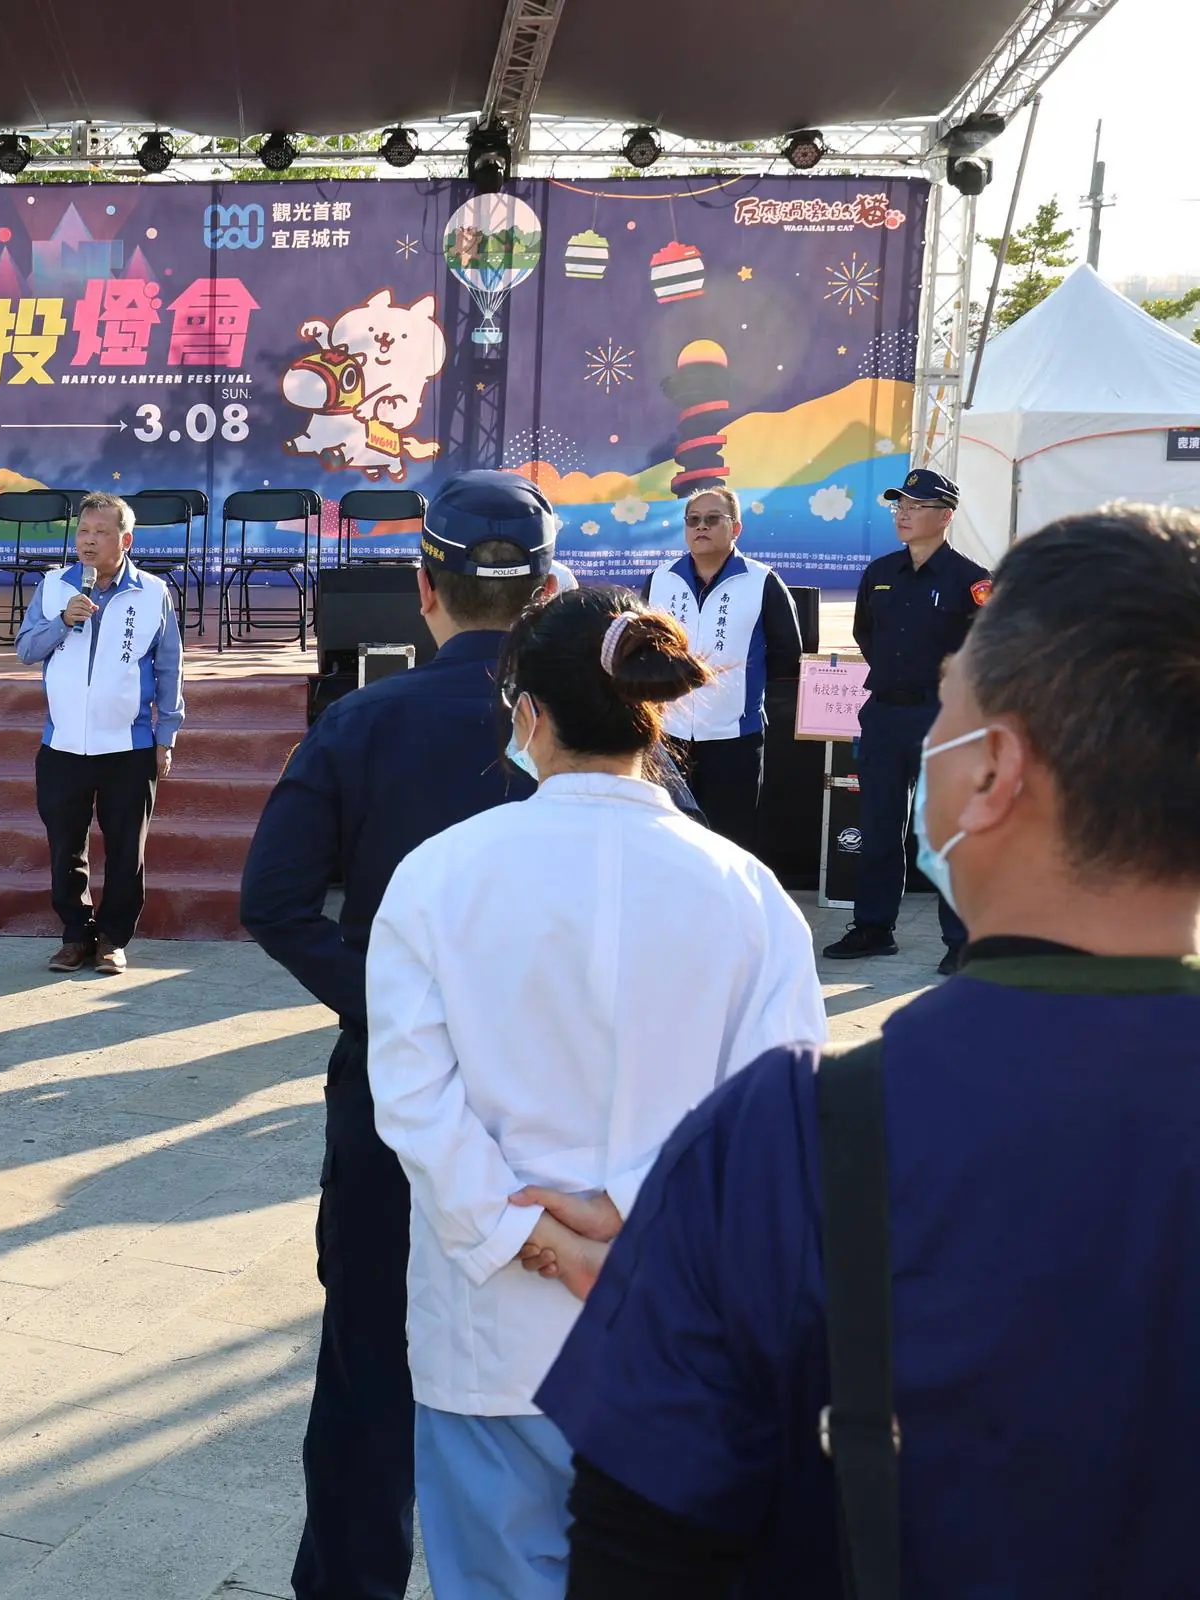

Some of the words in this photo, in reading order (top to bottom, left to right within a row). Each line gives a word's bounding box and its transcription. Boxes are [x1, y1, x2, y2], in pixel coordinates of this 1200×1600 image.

[271, 201, 351, 222] 觀光首都
[734, 193, 891, 228] 反應過激的貓
[271, 228, 351, 249] 宜居城市
[837, 224, 855, 232] CAT
[61, 375, 117, 384] NANTOU
[120, 374, 183, 384] LANTERN
[187, 374, 253, 384] FESTIVAL
[221, 388, 252, 399] SUN.
[133, 403, 250, 443] 3.08
[714, 592, 730, 651] 南投縣政府
[120, 605, 136, 664] 南投縣政府
